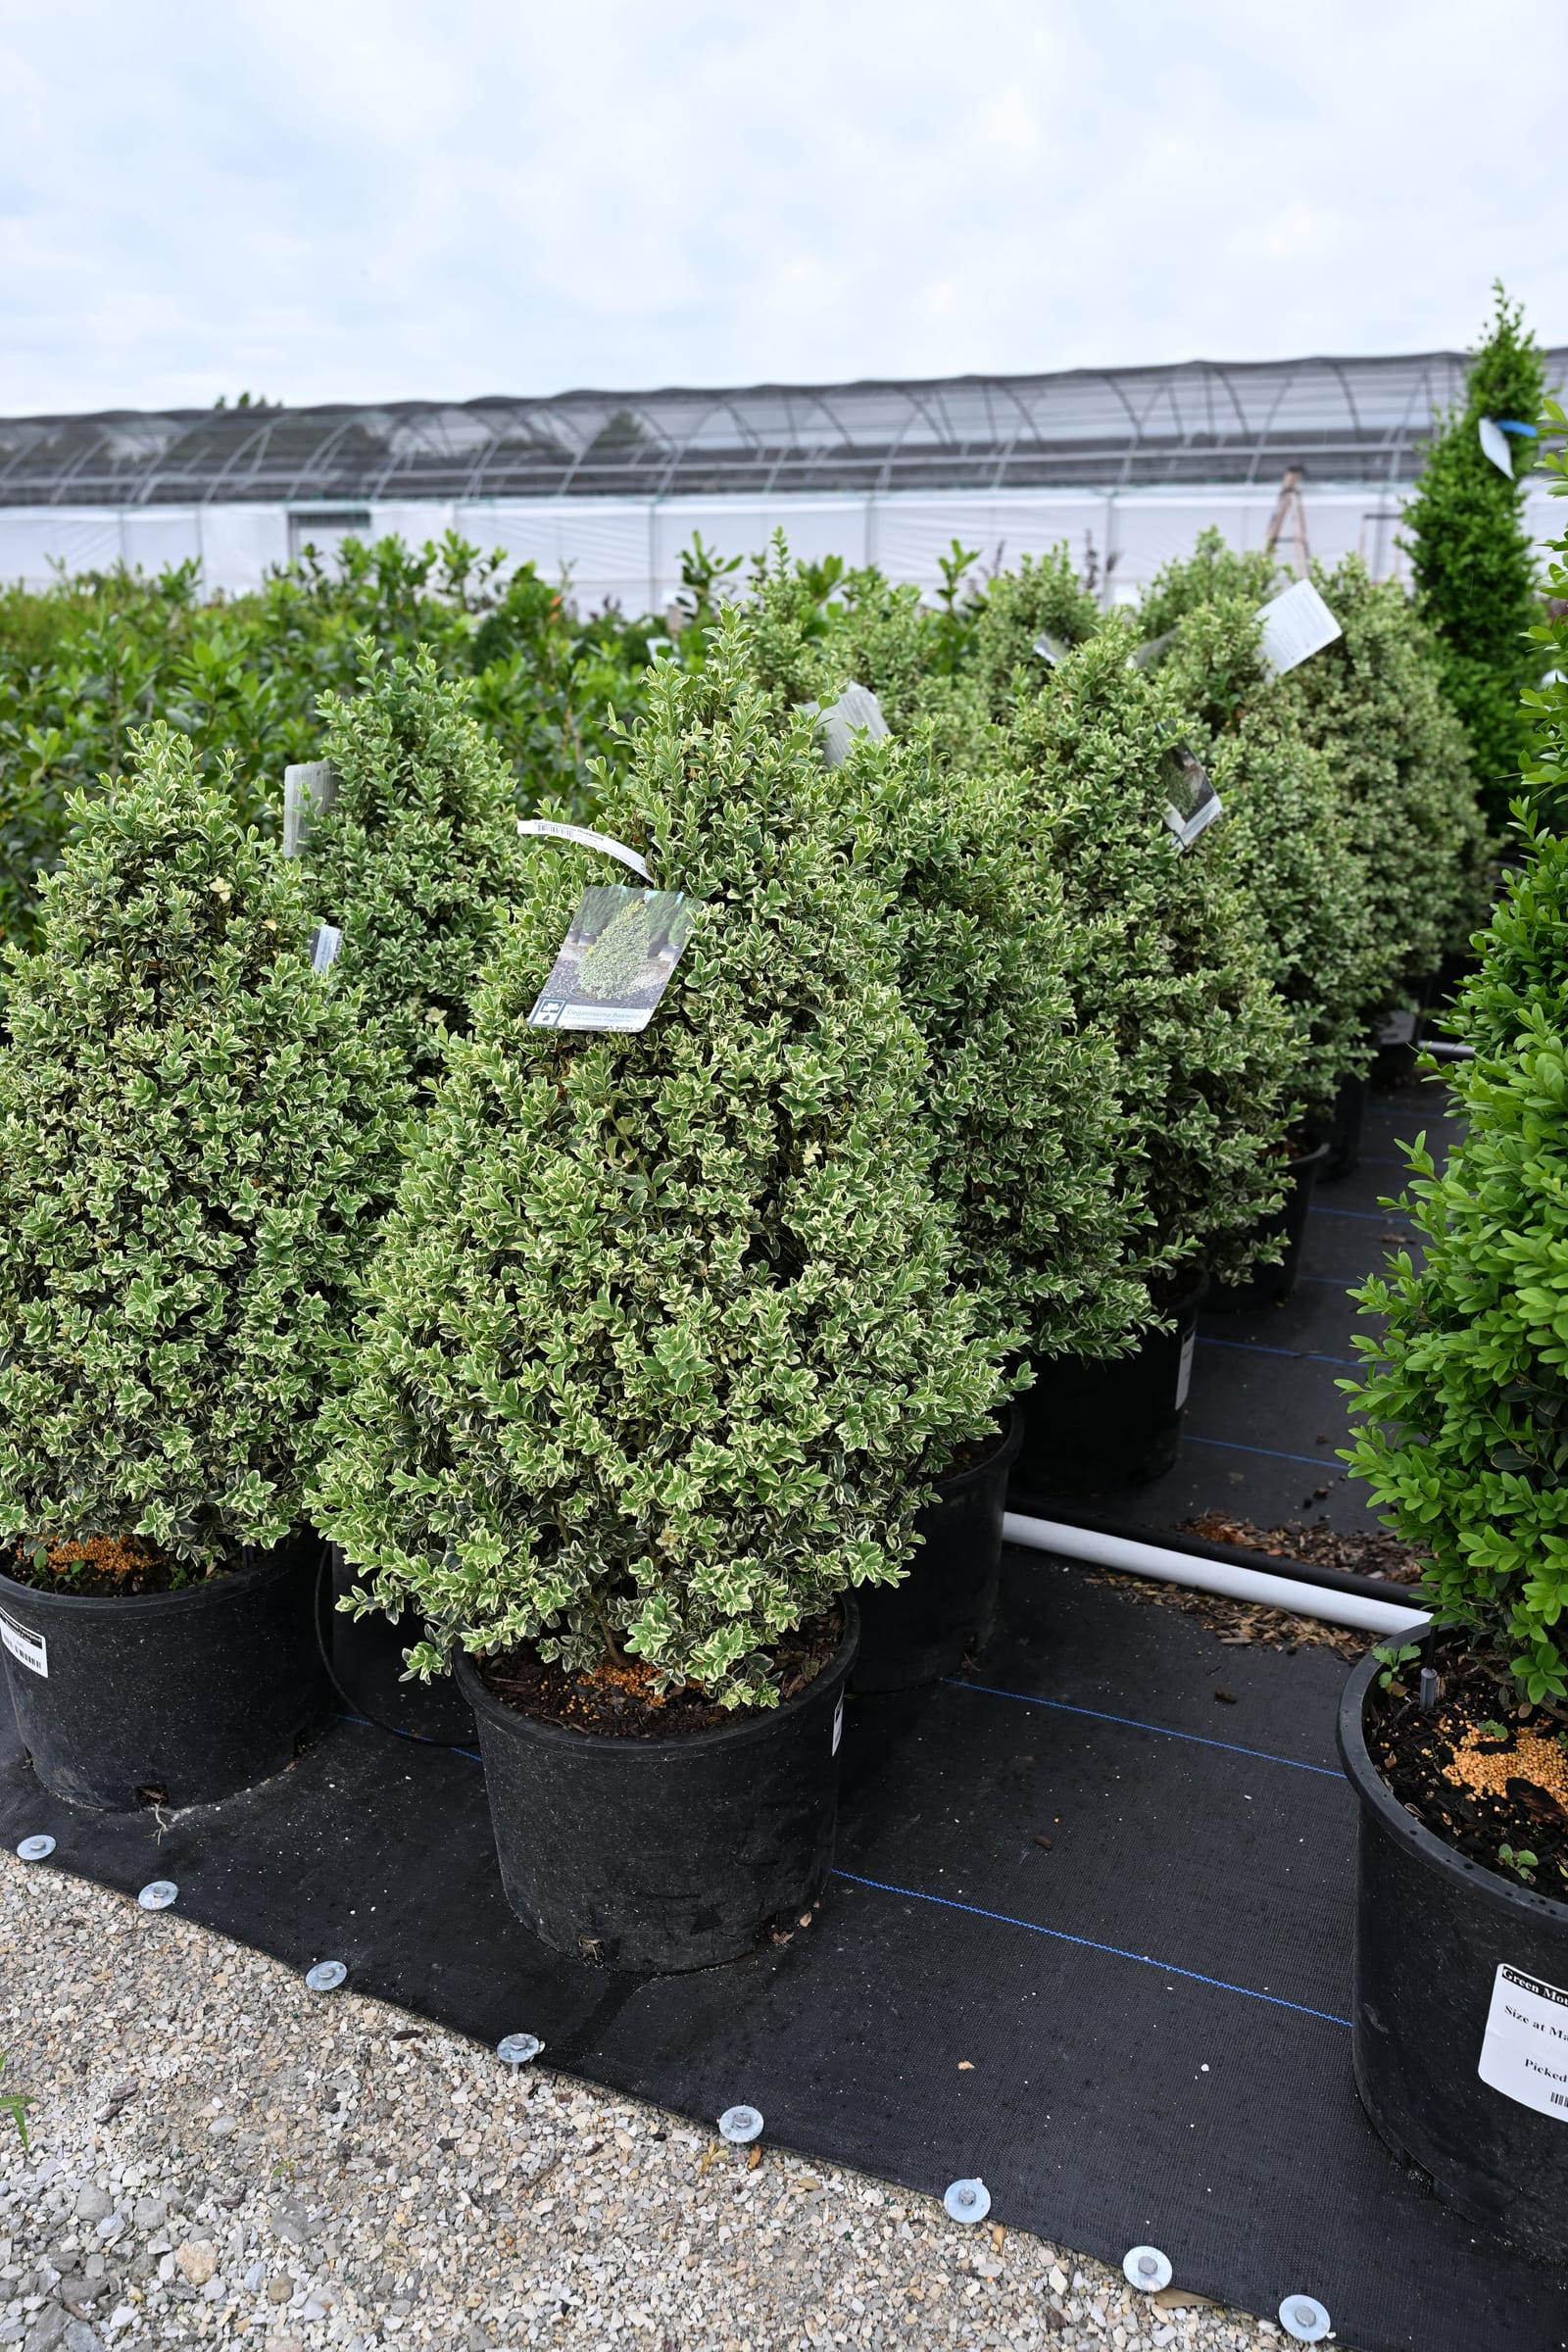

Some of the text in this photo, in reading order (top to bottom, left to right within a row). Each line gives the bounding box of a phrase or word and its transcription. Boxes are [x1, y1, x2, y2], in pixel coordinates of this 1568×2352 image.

[1502, 1969, 1539, 1993] Green
[1504, 2005, 1568, 2041] Size at Ma
[1525, 2057, 1567, 2083] Picked
